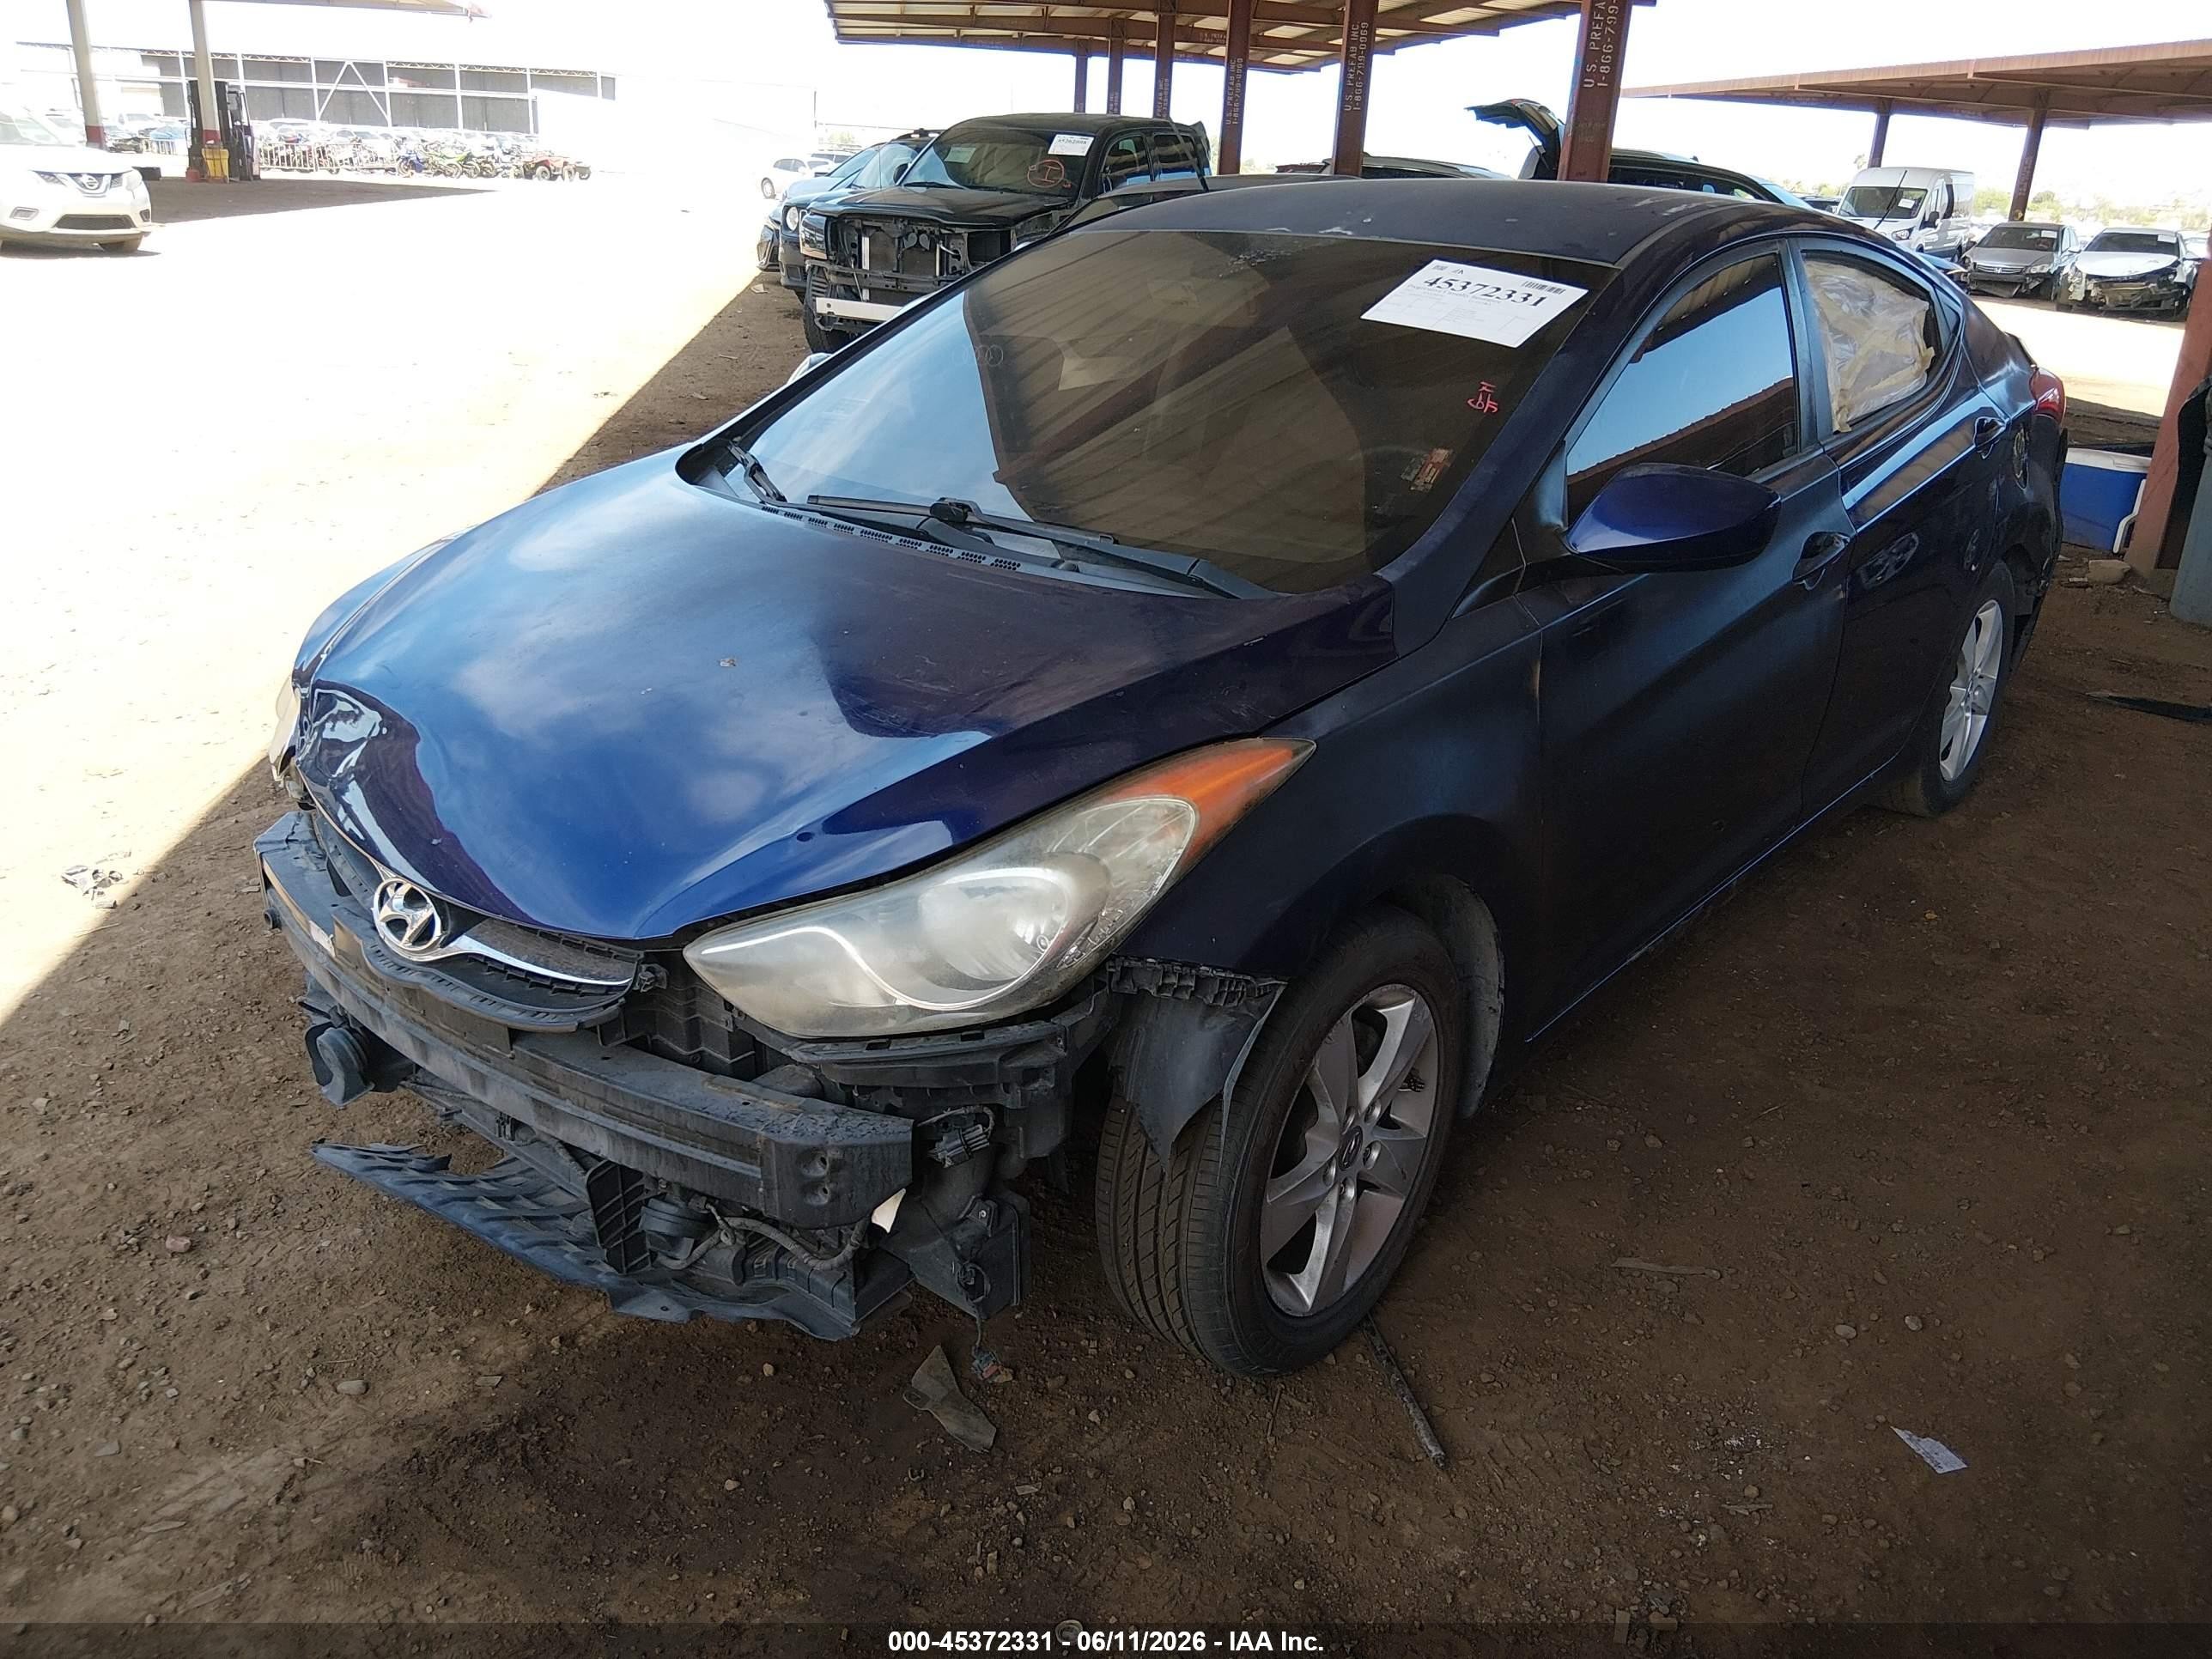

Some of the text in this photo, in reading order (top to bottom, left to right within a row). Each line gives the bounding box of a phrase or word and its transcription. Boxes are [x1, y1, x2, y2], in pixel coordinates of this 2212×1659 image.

[1344, 21, 1360, 111] U.S. PREFAB INC.
[1423, 276, 1547, 307] 45372331
